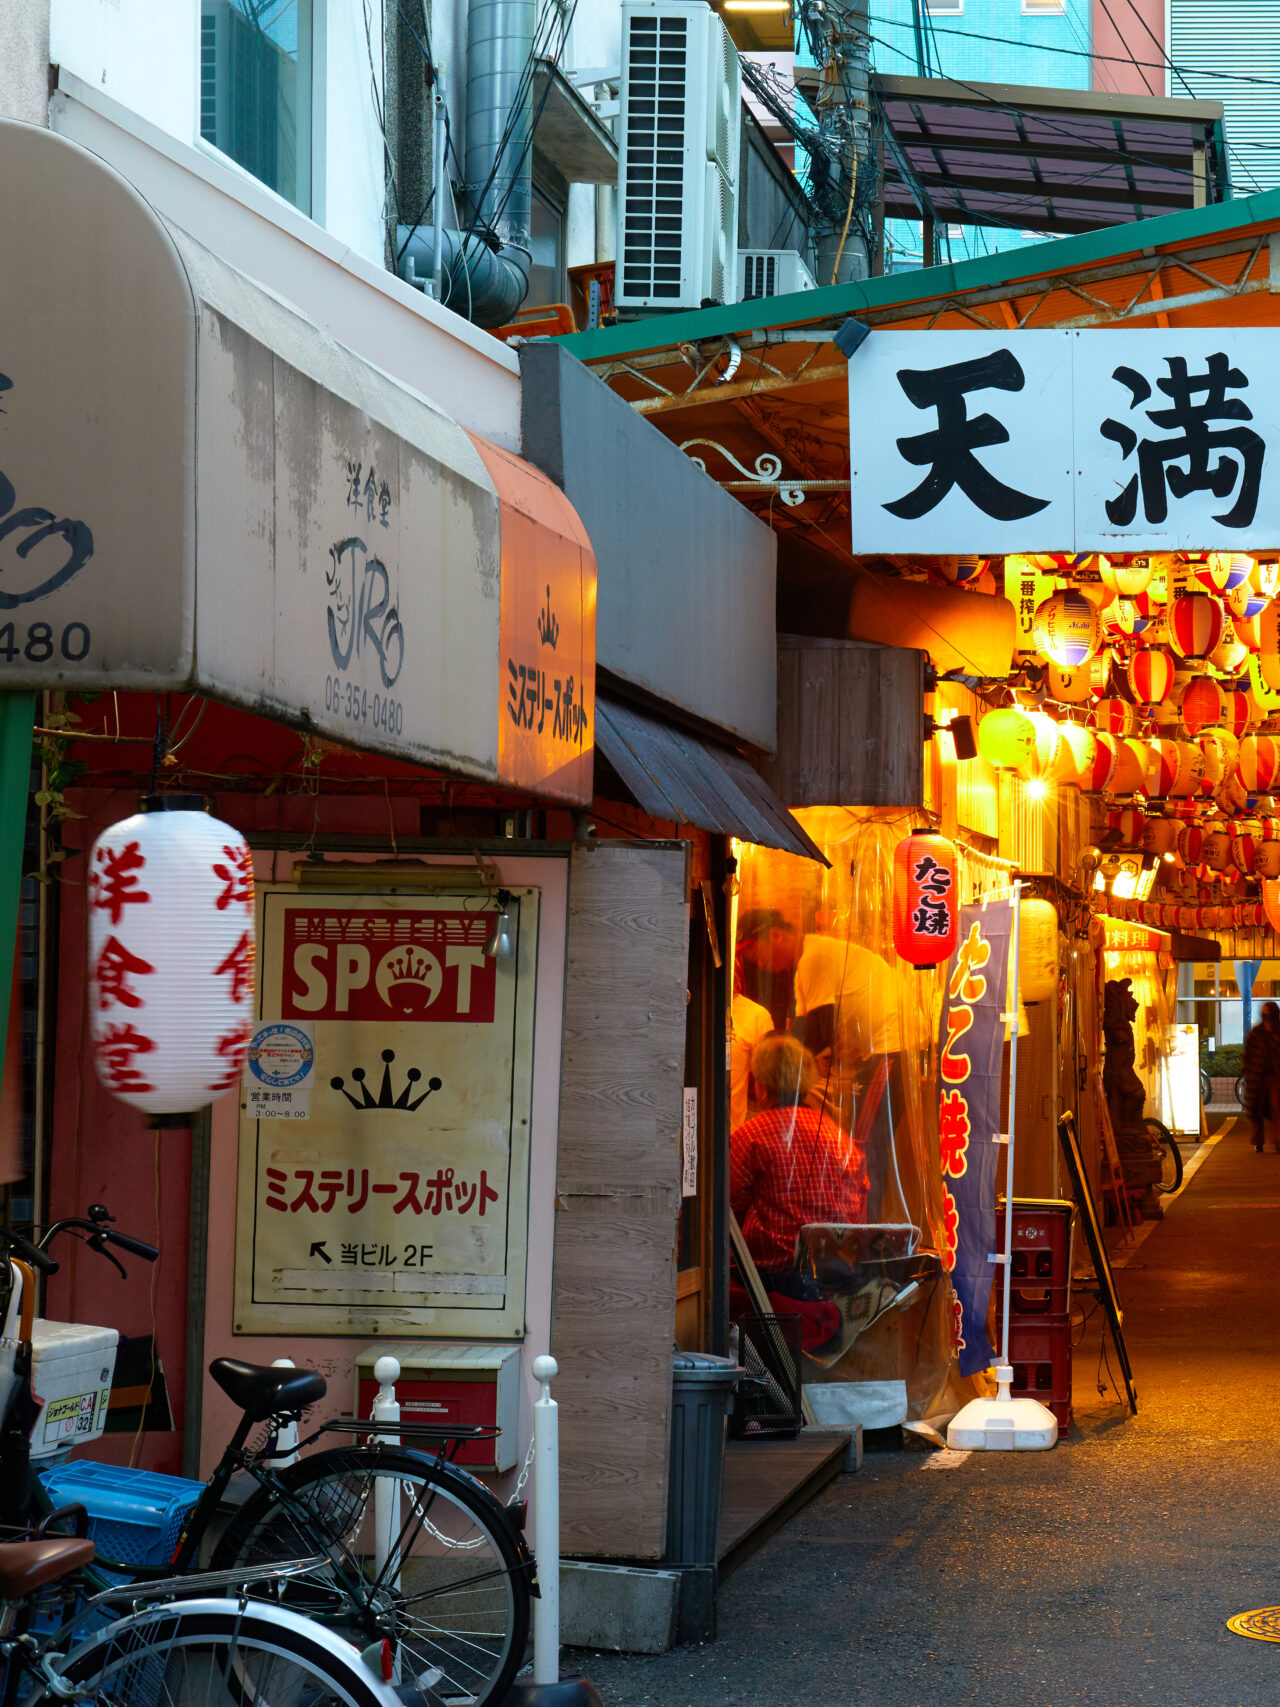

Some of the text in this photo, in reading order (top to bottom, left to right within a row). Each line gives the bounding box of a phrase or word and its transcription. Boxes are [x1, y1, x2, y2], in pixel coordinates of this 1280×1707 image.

[347, 462, 391, 529] 洋食堂
[1020, 572, 1036, 634] 一番搾り
[1047, 605, 1059, 650] アサヒビール
[325, 675, 403, 736] 06-354-0480
[508, 657, 588, 747] ミステリースポット
[912, 855, 951, 937] たこ焼
[90, 842, 154, 1094] 洋食堂
[292, 943, 486, 1014] SPOT
[251, 1092, 292, 1103] 営業時間
[265, 1167, 499, 1217] ミステリースポット
[340, 1242, 434, 1268] 当ビル 2F
[77, 1416, 89, 1431] 32
